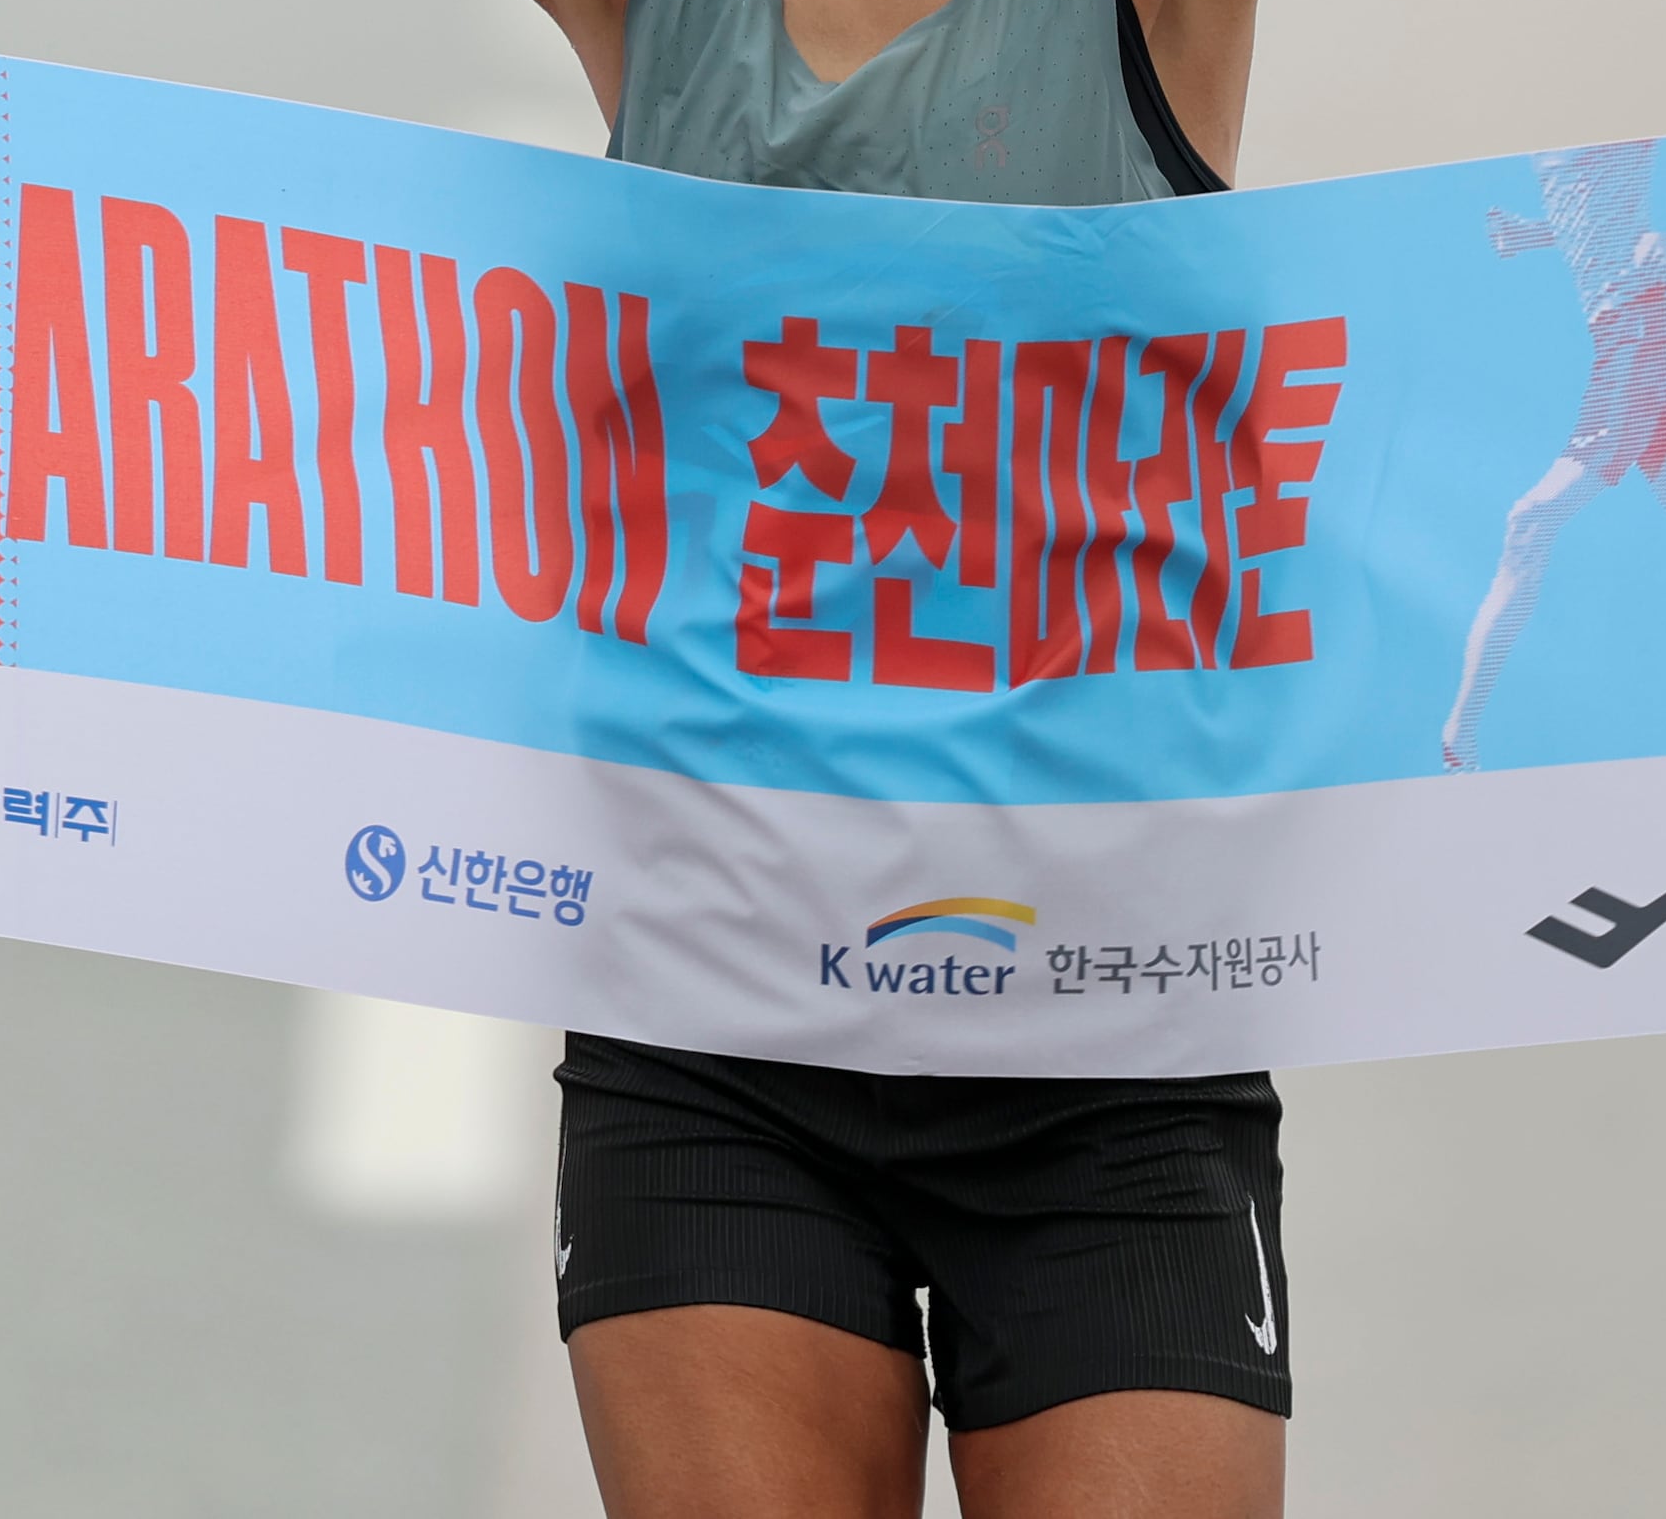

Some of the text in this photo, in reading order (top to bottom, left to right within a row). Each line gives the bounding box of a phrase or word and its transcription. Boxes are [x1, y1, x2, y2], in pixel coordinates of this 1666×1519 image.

[736, 315, 1348, 694] 춘천마라톤
[417, 845, 594, 927] 신한은행
[820, 931, 1322, 996] K water 한국수자원공사
